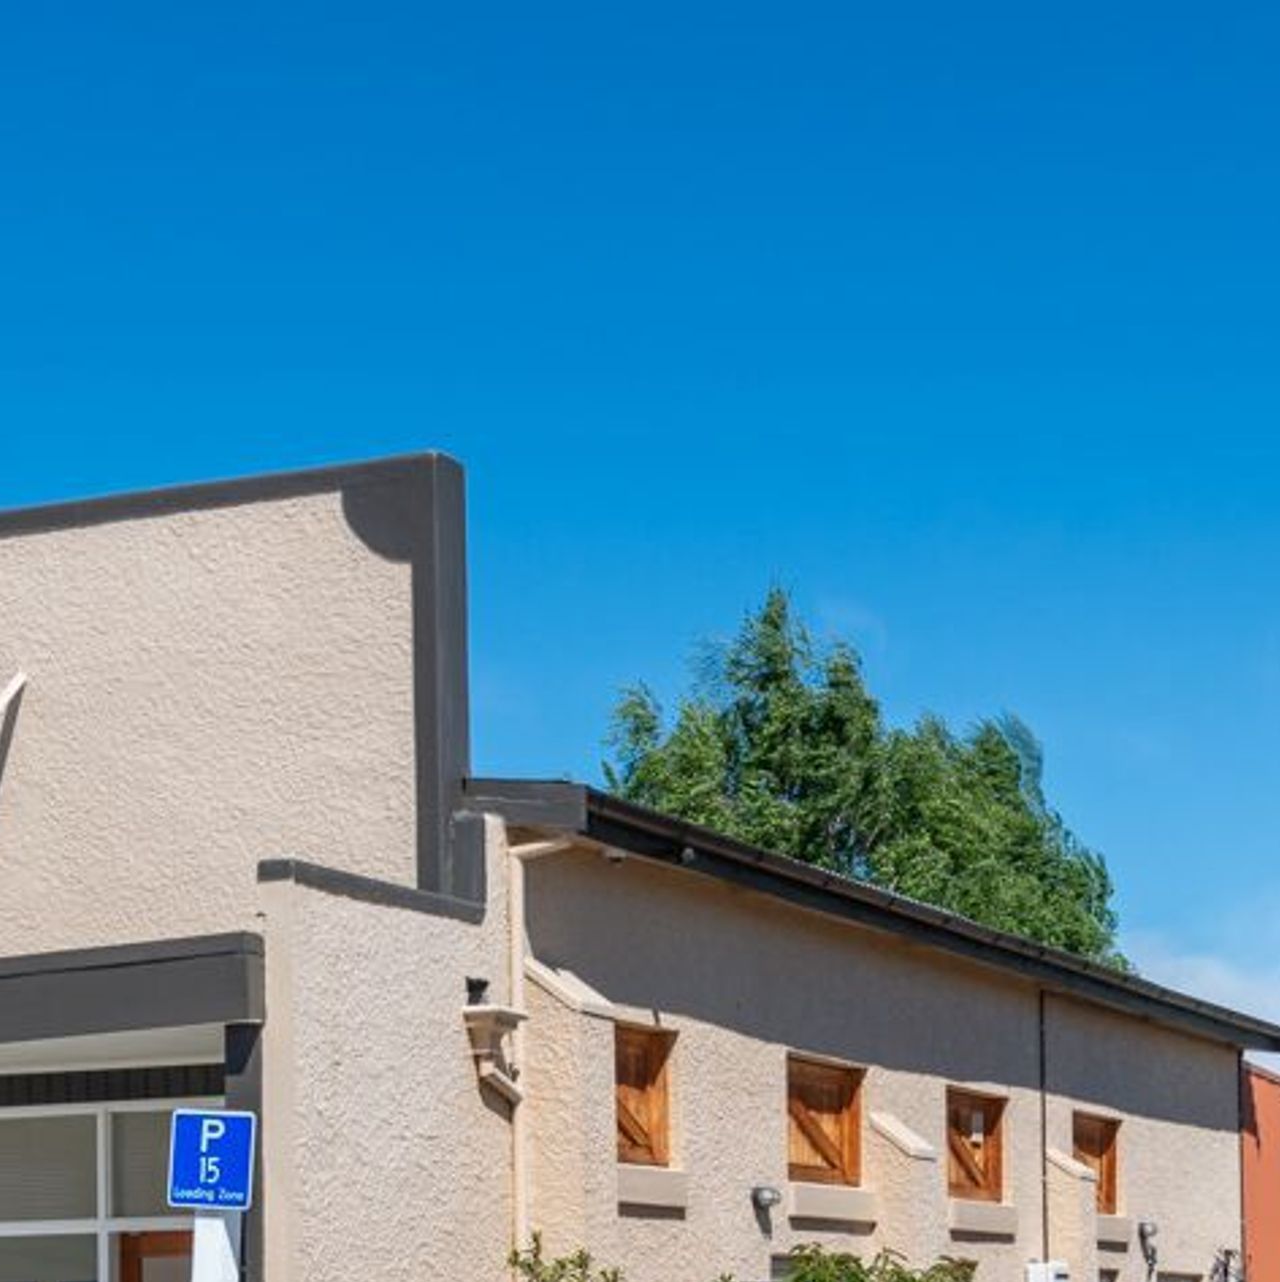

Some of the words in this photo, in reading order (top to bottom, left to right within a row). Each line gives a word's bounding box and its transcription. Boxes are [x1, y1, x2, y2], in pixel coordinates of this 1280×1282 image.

[200, 1119, 225, 1153] P
[200, 1157, 220, 1183] 15
[173, 1186, 214, 1201] Loading
